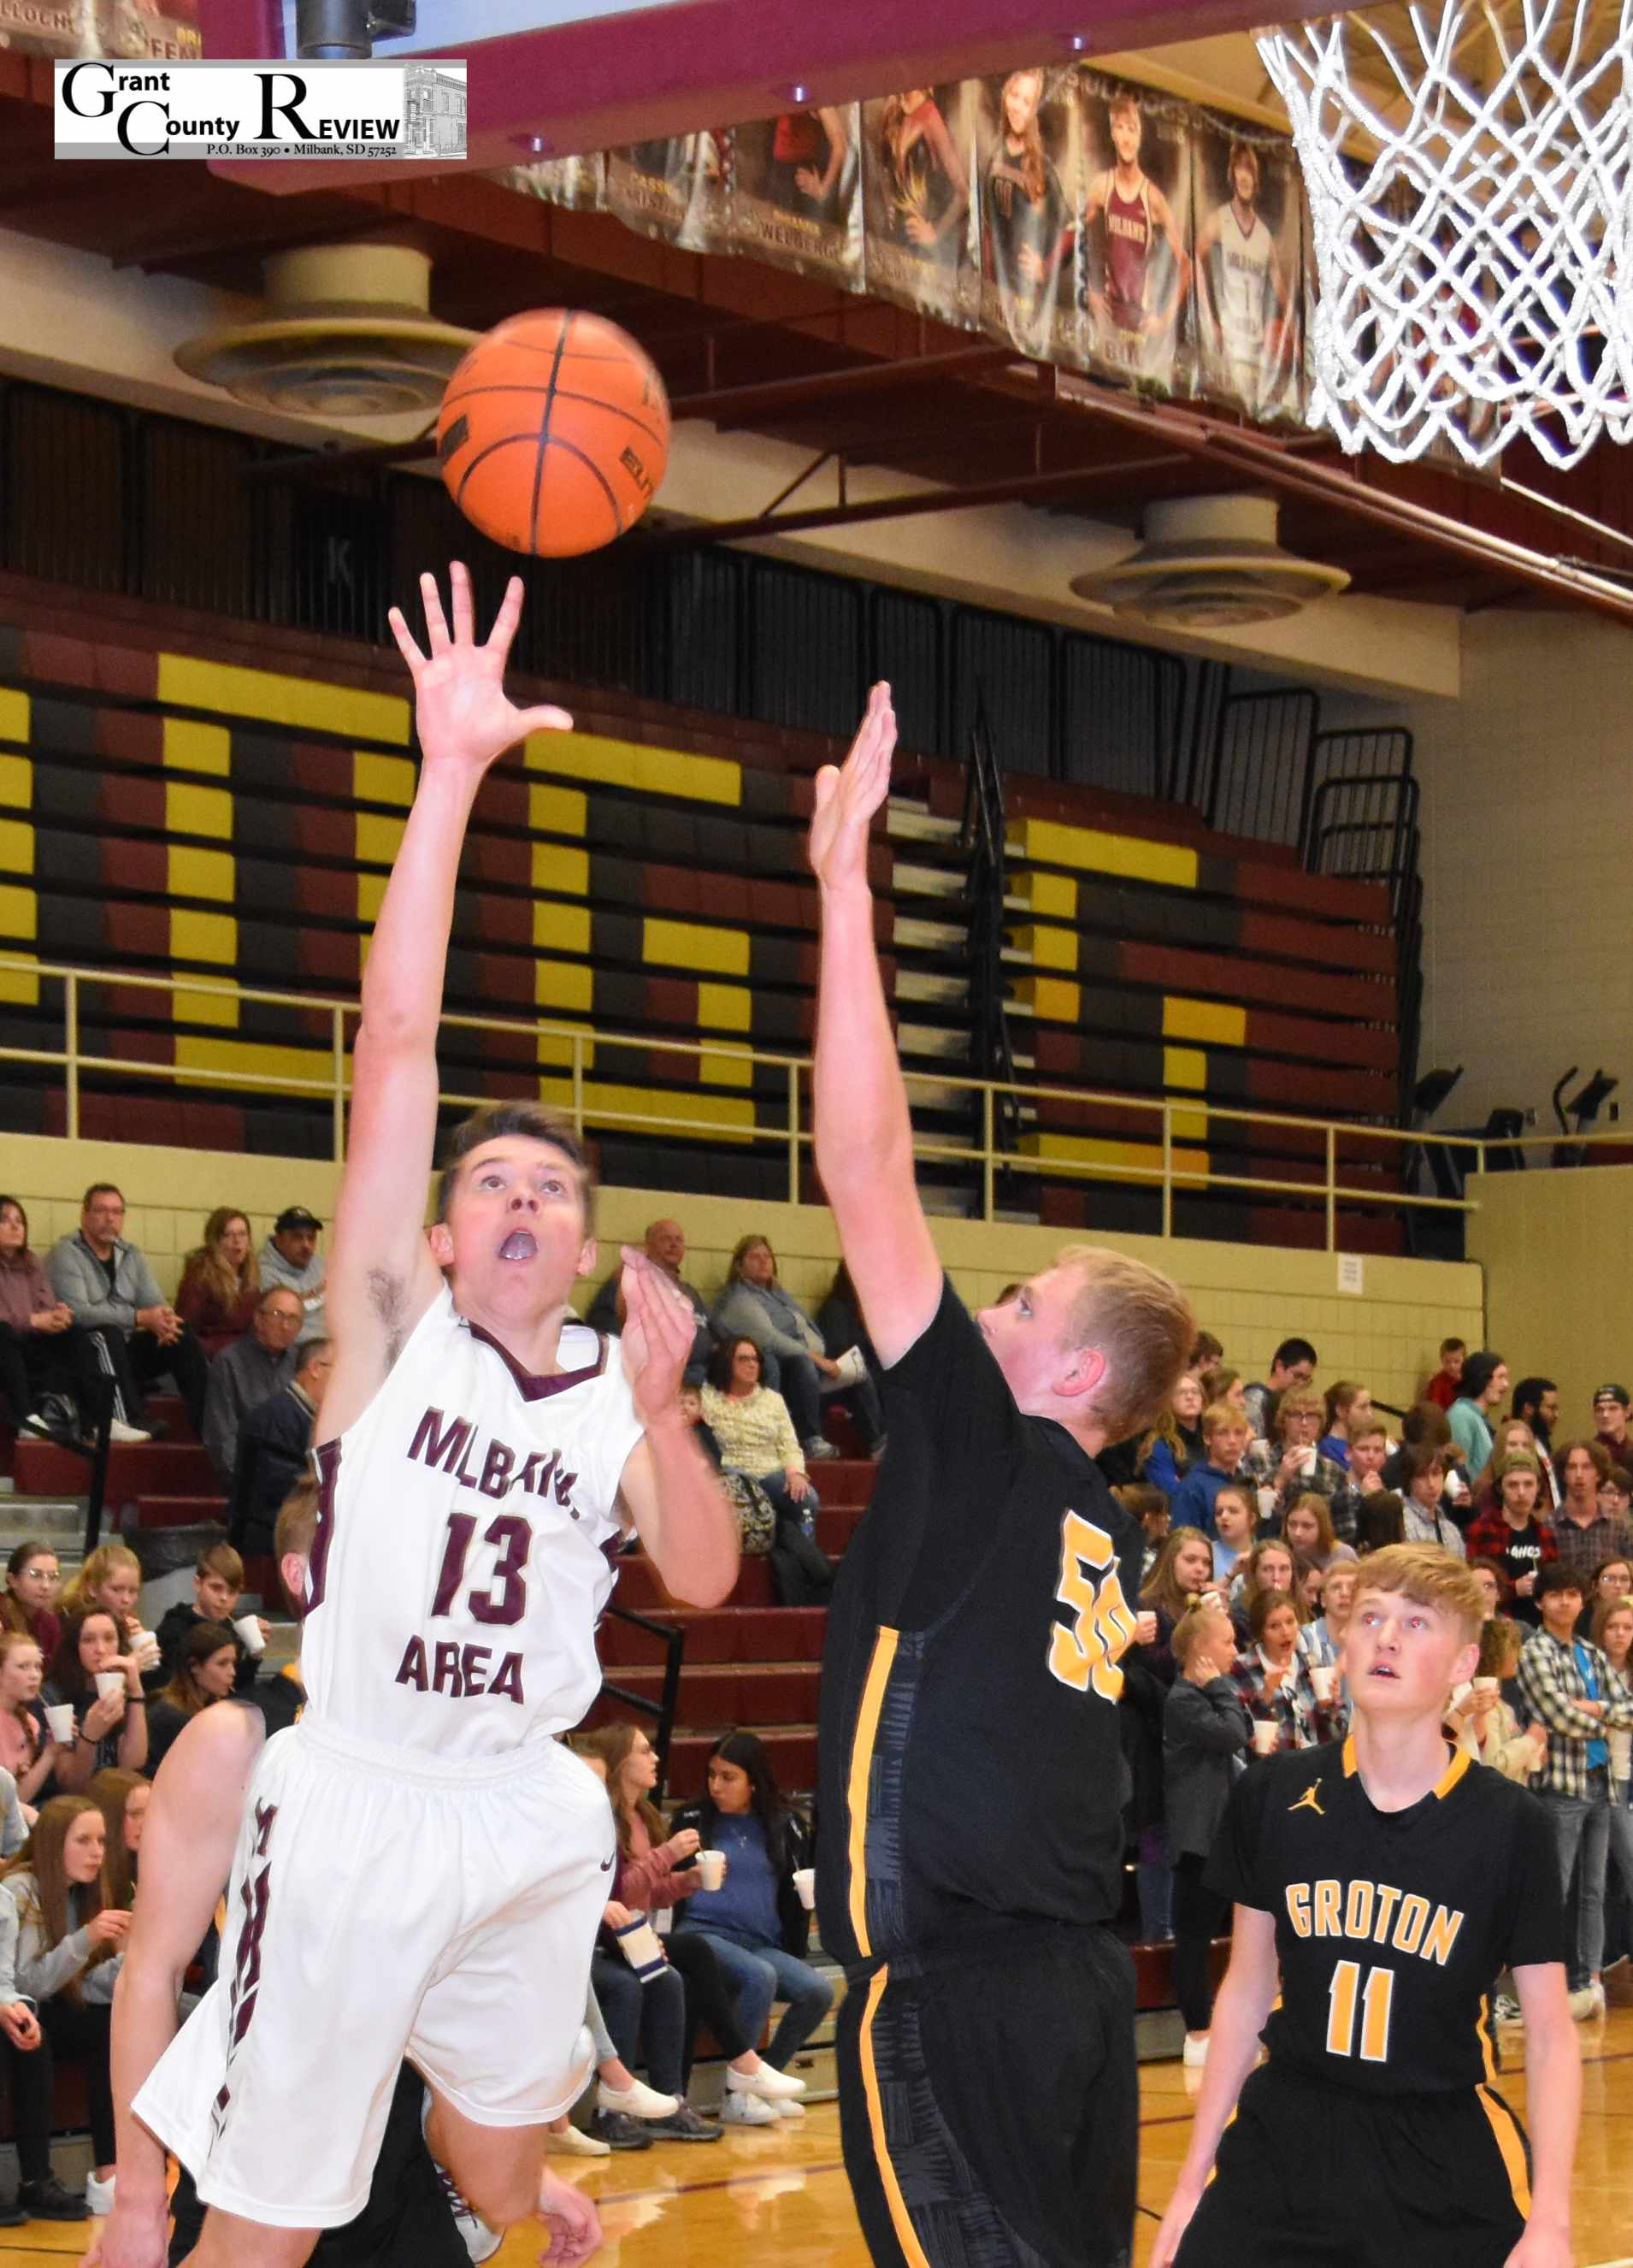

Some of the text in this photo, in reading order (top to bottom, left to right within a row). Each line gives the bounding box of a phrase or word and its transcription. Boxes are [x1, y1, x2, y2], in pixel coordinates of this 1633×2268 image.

[430, 1511, 533, 1627] 13
[394, 1633, 524, 1705] AREA
[1286, 1879, 1465, 1966] GROTON
[1326, 1959, 1395, 2063] 11
